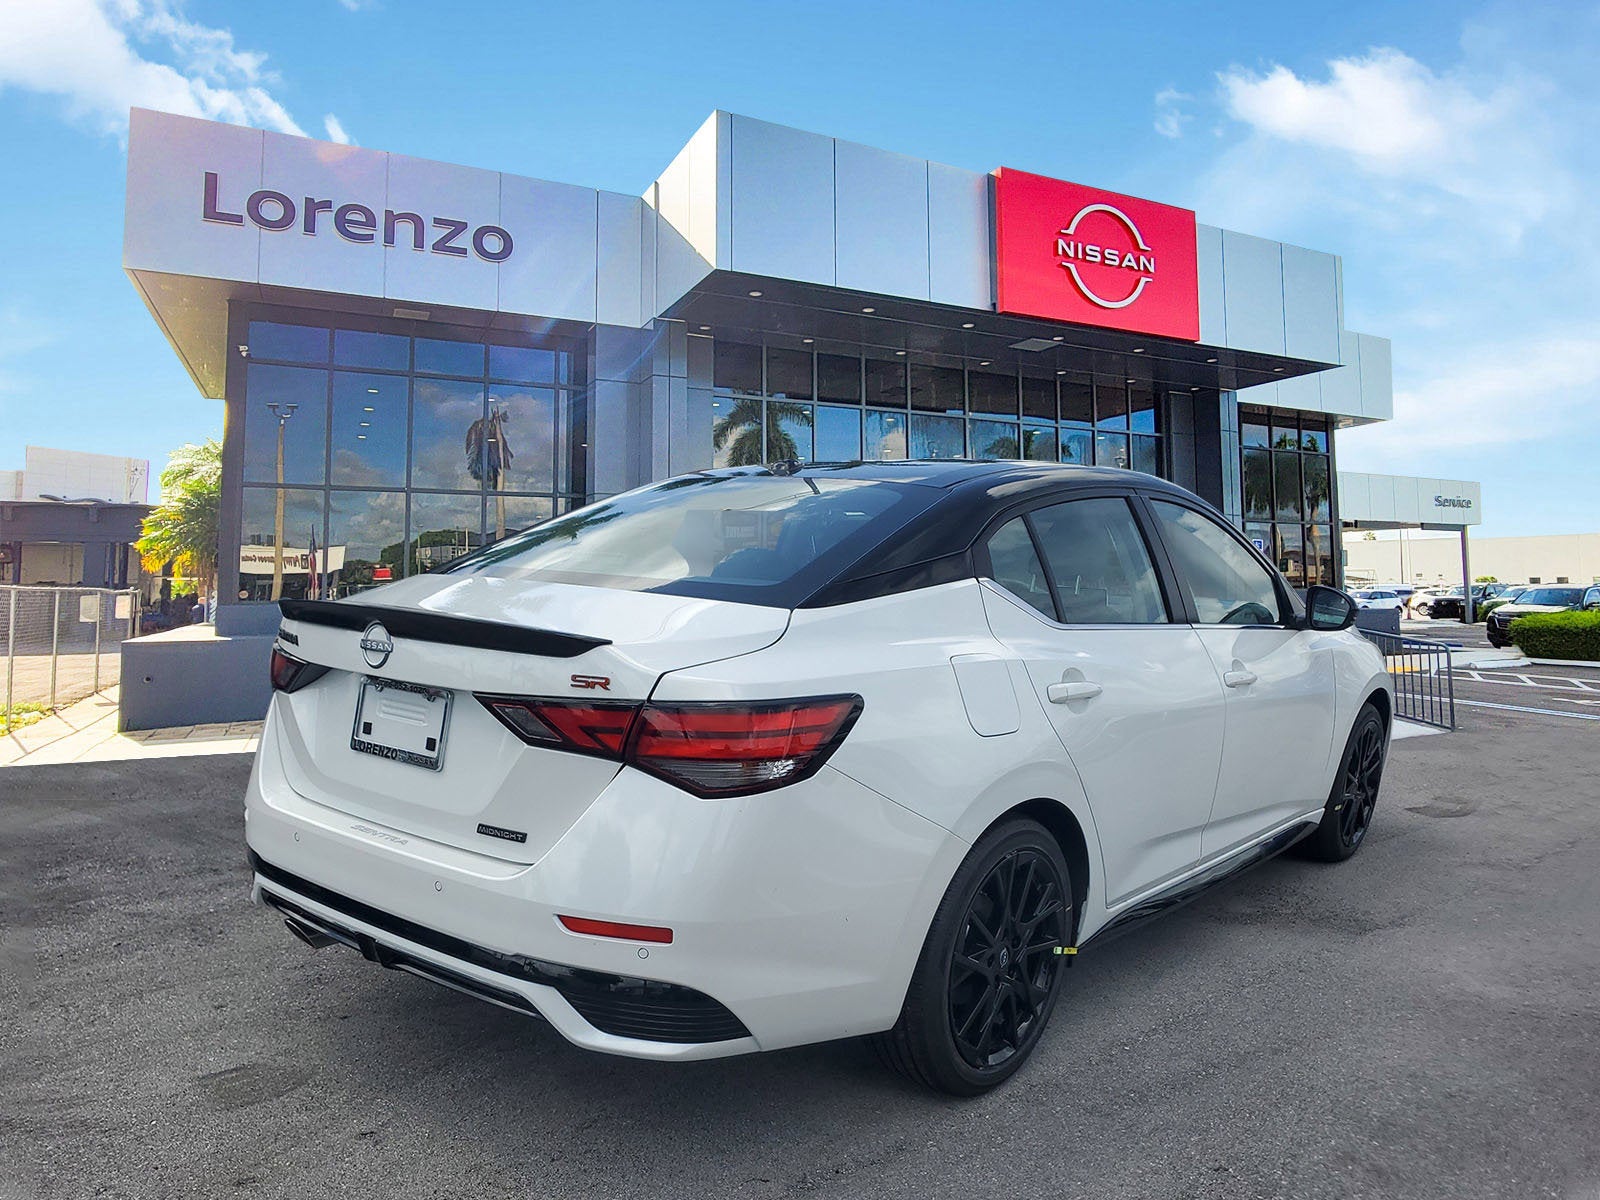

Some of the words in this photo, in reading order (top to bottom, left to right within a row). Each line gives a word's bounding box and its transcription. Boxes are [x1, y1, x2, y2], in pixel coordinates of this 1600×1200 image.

[202, 171, 514, 263] Lorenzo
[1057, 238, 1155, 273] NISSAN
[1434, 495, 1472, 509] Service
[570, 674, 611, 691] SR
[353, 739, 399, 761] LORENZO
[478, 825, 524, 842] MIDNIGHT
